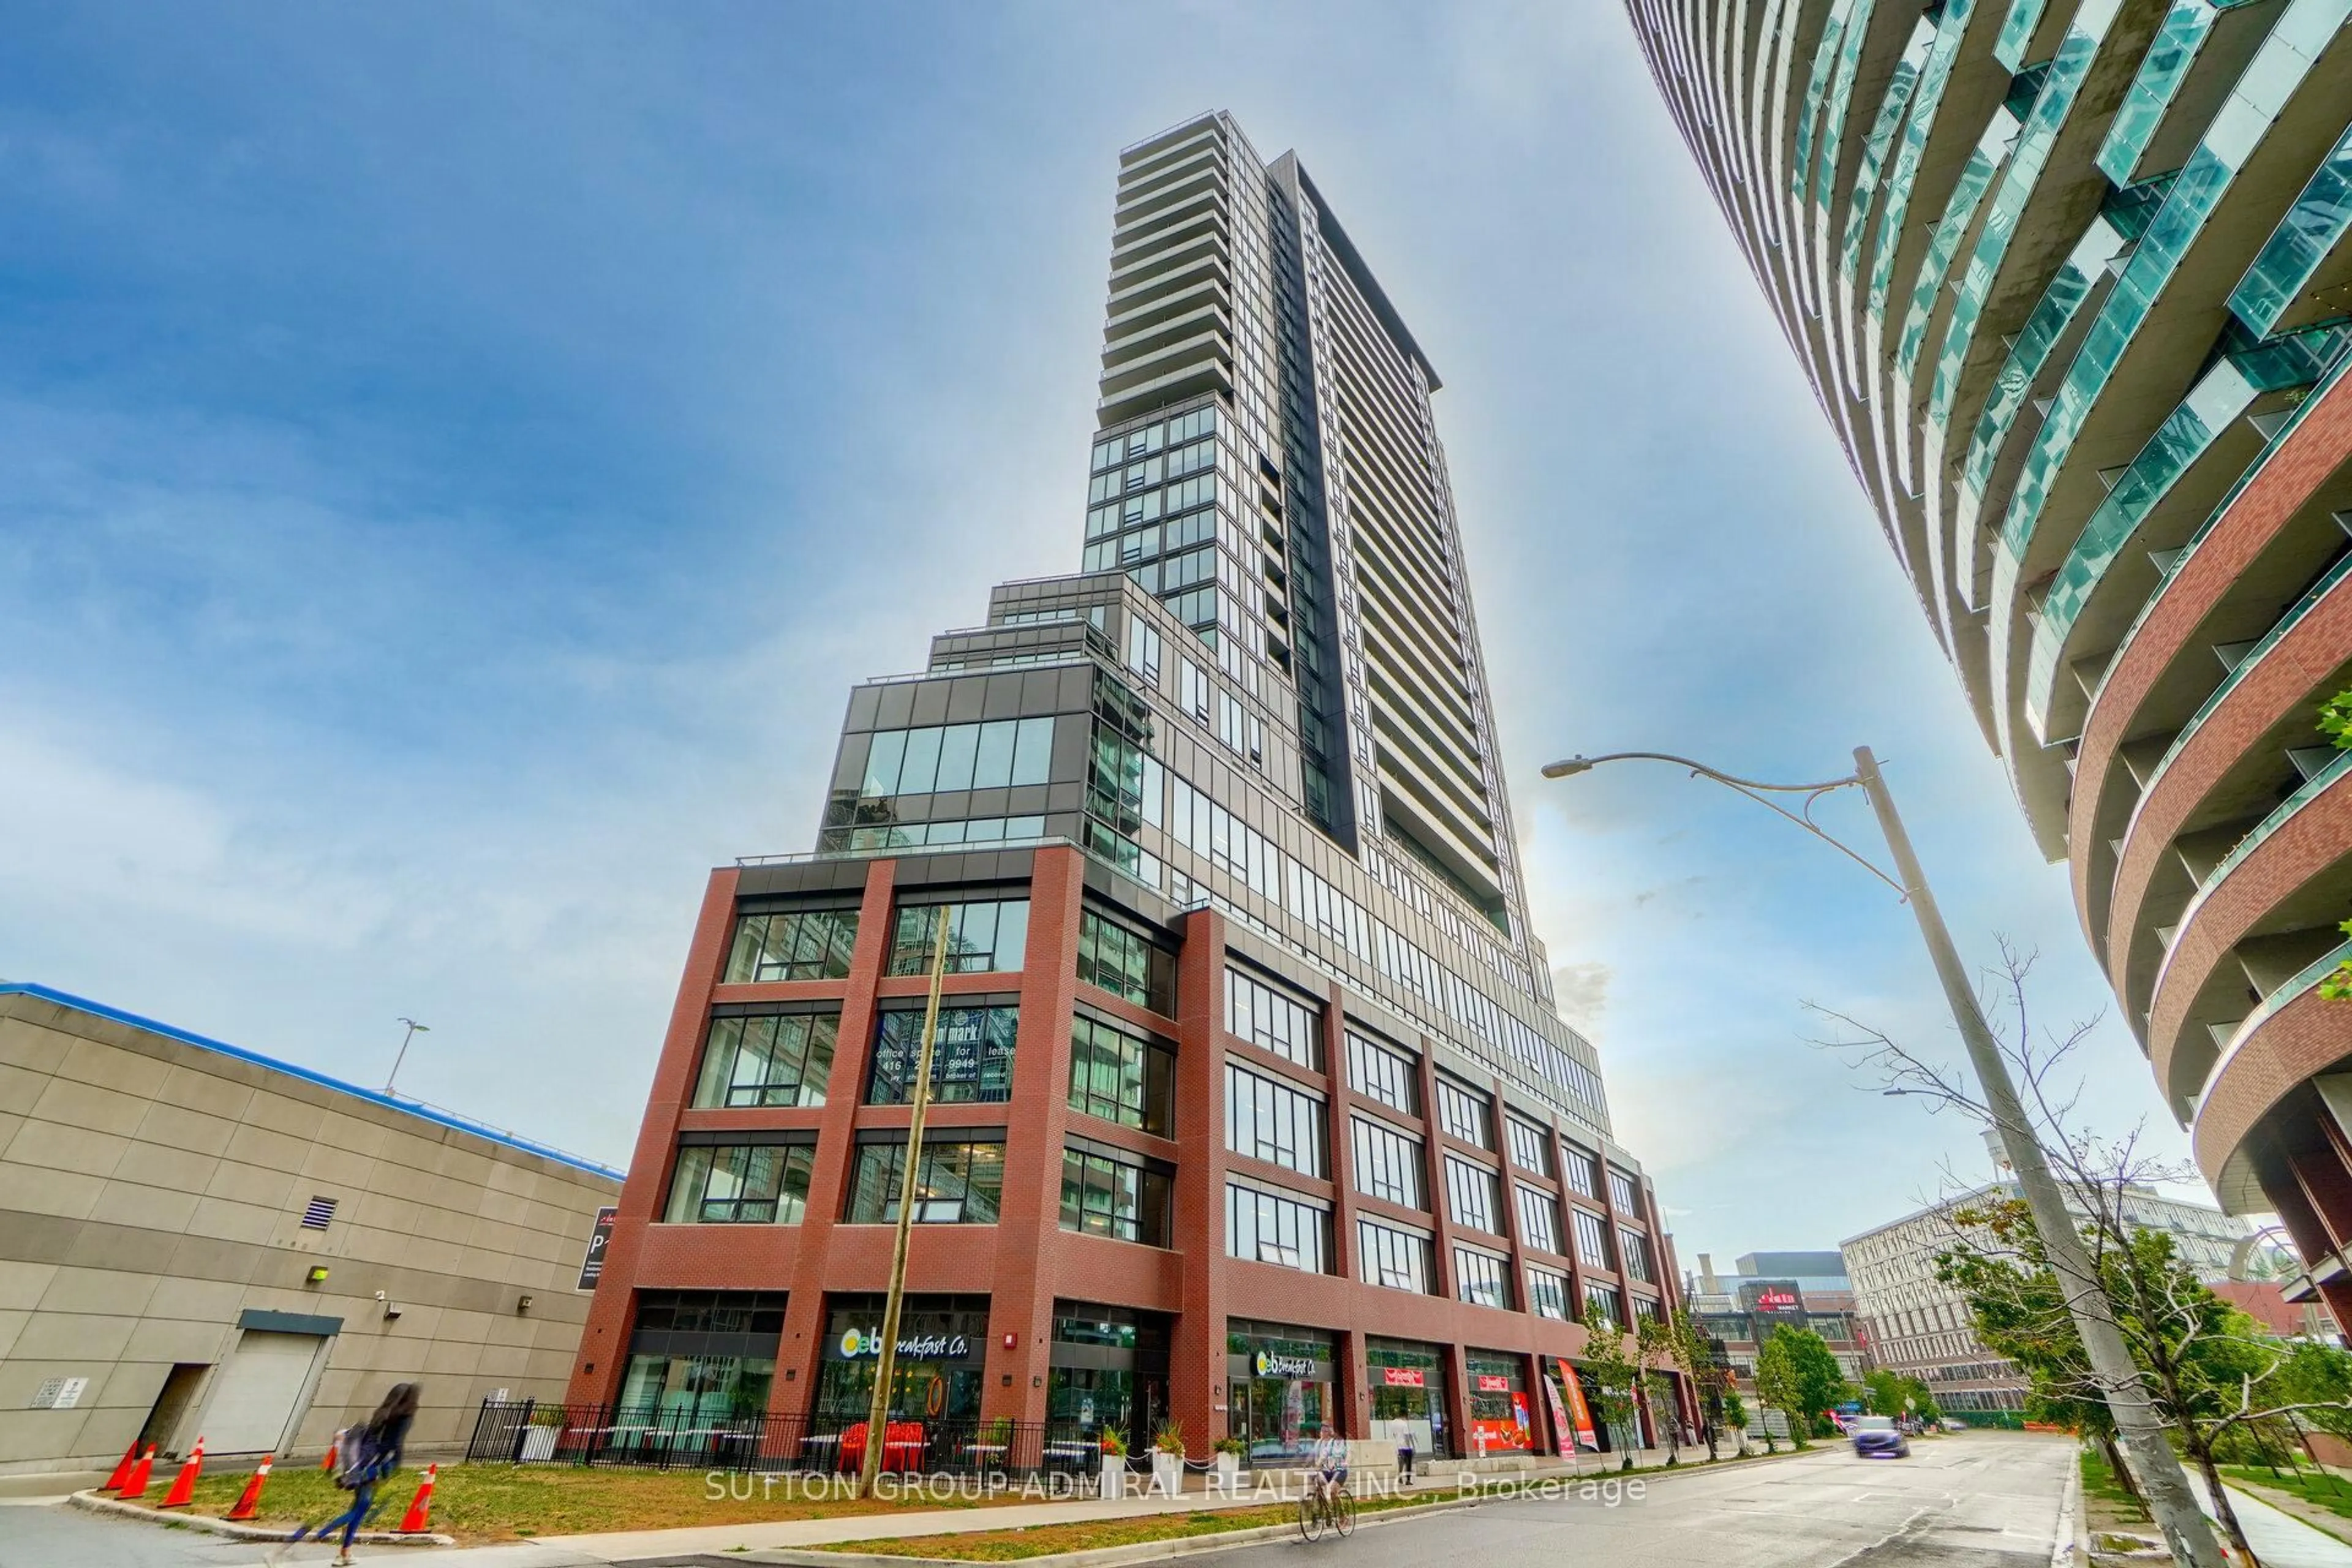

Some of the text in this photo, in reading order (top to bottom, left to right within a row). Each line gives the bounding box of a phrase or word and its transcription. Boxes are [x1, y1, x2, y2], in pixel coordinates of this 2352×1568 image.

[876, 1046, 1016, 1059] office spe for lease
[882, 1058, 975, 1071] 416 9949
[895, 1335, 946, 1361] reakfast
